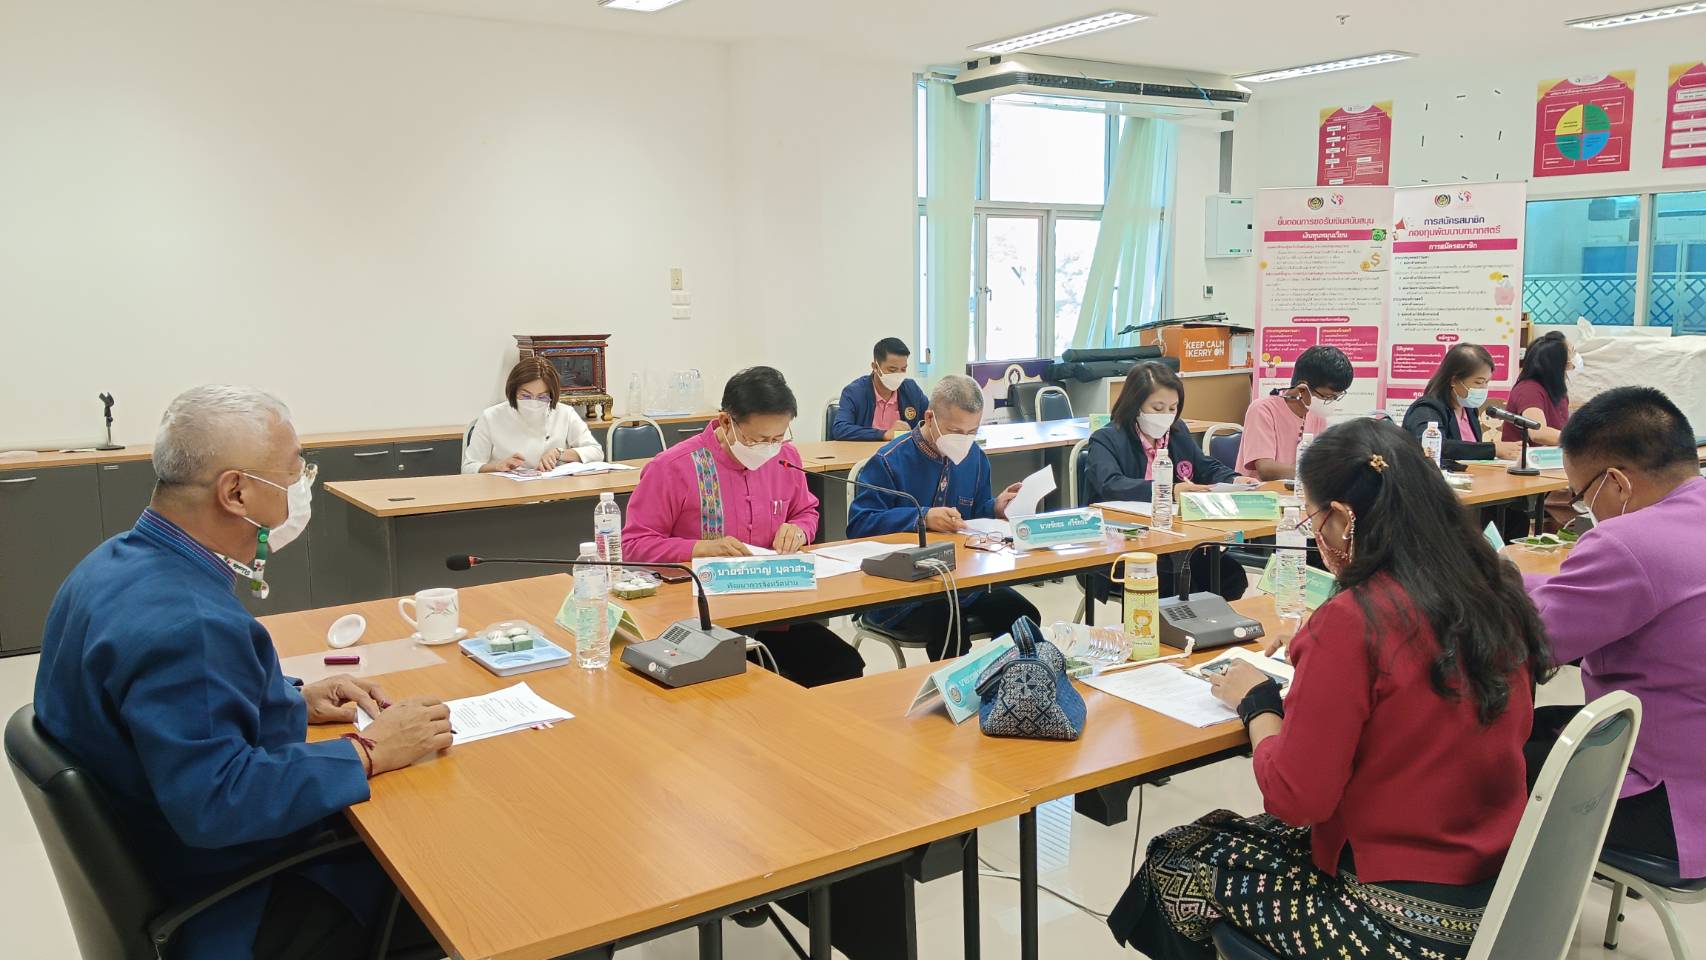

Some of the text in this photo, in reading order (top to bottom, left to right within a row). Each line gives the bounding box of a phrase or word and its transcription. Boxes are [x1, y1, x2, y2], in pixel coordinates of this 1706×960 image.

[1424, 215, 1485, 226] การสมัครสมาชิก
[1408, 225, 1501, 238] กองทุนพัฒนาบทบาทสตรี
[1185, 340, 1225, 349] KEEP CALM
[1188, 348, 1212, 358] KERRY
[1214, 347, 1225, 356] ON
[717, 565, 772, 576] นายชำนาญ
